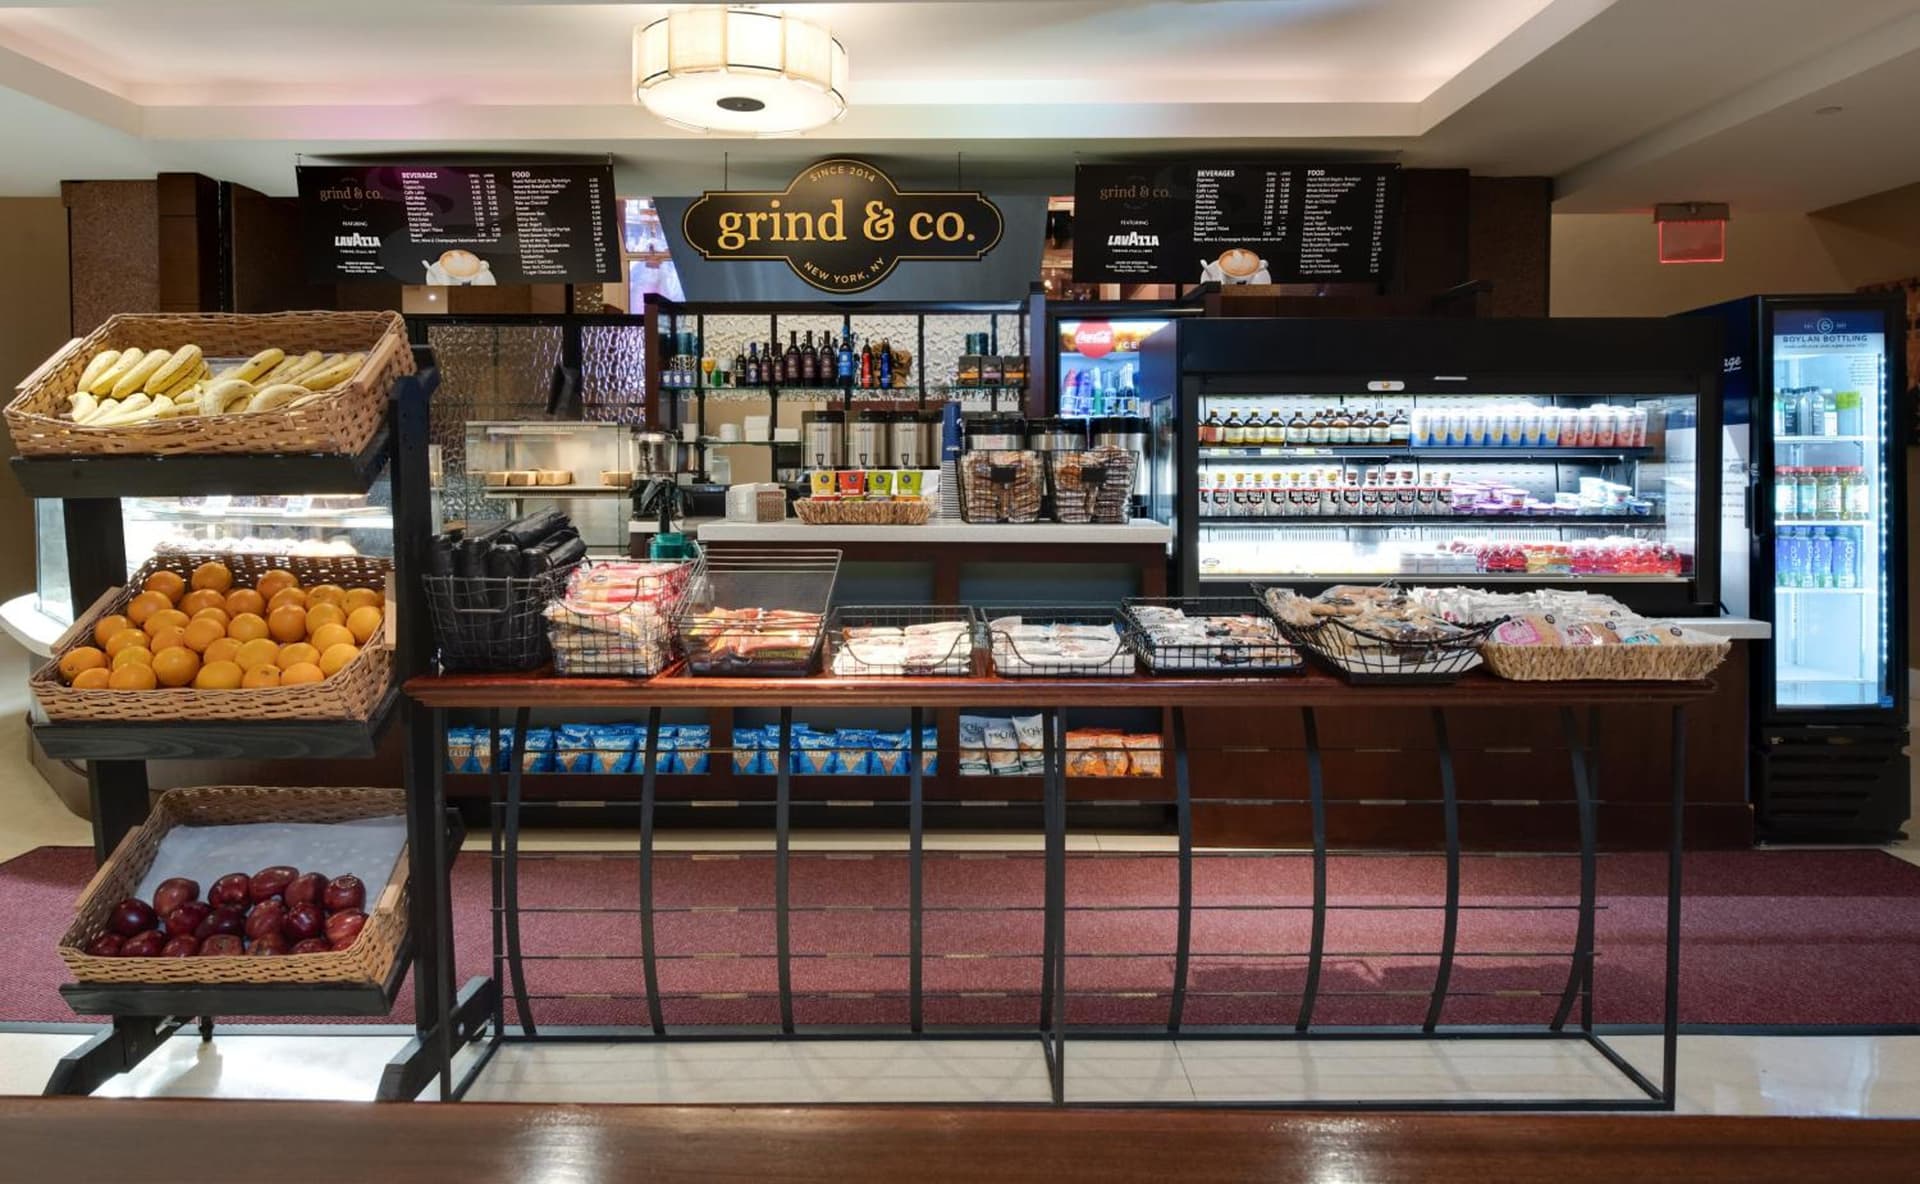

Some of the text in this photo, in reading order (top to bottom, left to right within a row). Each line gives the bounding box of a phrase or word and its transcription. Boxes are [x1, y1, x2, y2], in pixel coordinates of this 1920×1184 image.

[809, 165, 876, 183] SINCE 2014
[320, 186, 351, 201] grind
[354, 187, 363, 199] &
[1100, 185, 1136, 200] grind
[1139, 185, 1149, 198] &
[717, 198, 976, 250] grind & co.
[335, 232, 381, 247] LAVAZZA
[1107, 231, 1160, 246] LAVAZZA
[803, 260, 829, 282] NEW
[869, 256, 886, 274] NY
[1783, 334, 1868, 343] BOYLAN BOTTLING
